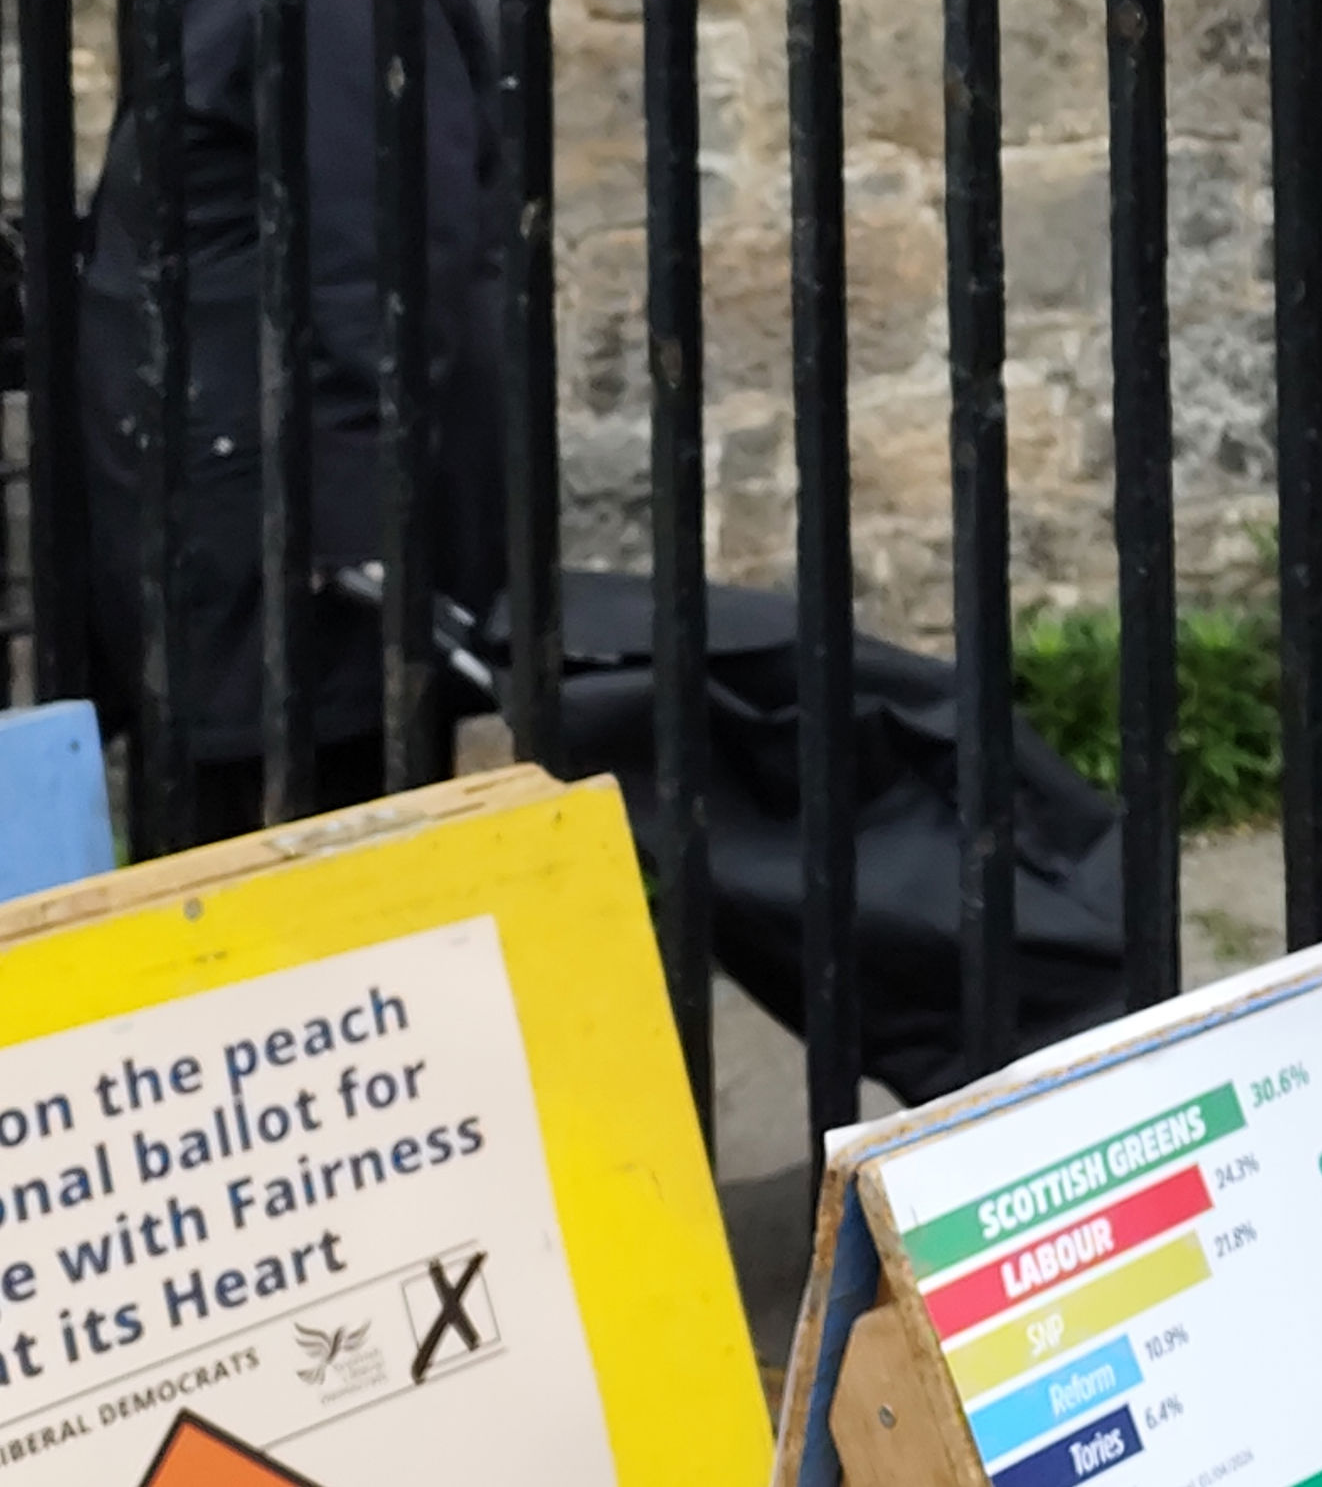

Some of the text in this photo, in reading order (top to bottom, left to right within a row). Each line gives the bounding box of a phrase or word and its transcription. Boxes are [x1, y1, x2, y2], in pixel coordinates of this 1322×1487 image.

[0, 986, 411, 1148] on the peach
[0, 1056, 428, 1227] nal ballot for
[979, 1063, 1310, 1239] SCOTTISH GREENS 30.6%
[57, 1195, 209, 1284] with
[229, 1115, 485, 1232] Fairness
[59, 1302, 144, 1363] its
[163, 1229, 347, 1328] Heart
[1001, 1217, 1114, 1299] LABOUR
[98, 1347, 260, 1427] DEMOCRATS
[1027, 1314, 1065, 1358] SNP
[1049, 1362, 1117, 1418] Reform
[1069, 1395, 1184, 1476] Tories 6.4%
